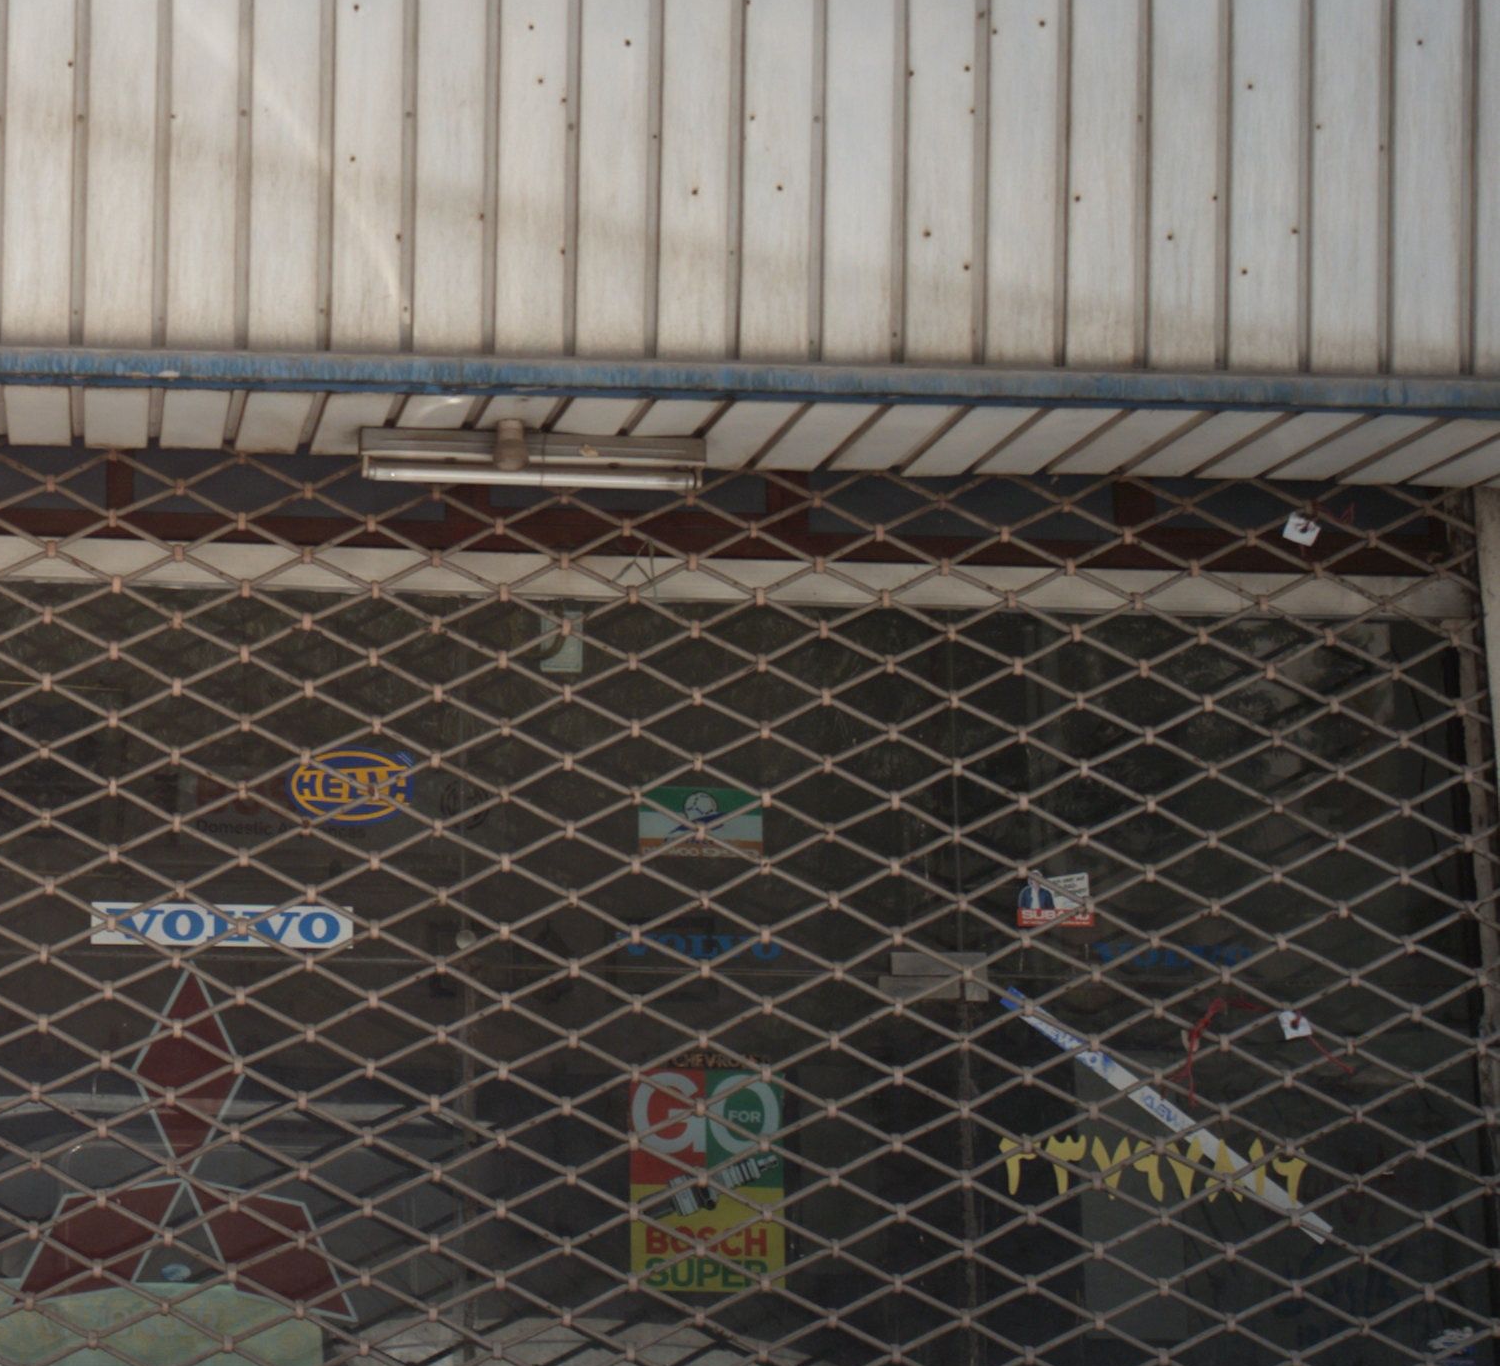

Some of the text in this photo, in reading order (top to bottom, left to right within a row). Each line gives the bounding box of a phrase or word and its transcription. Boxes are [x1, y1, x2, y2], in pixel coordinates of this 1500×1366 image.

[103, 908, 339, 944] VOLVO
[1021, 908, 1090, 922] SUBAU
[632, 1072, 779, 1154] GO
[728, 1109, 761, 1124] FOR
[646, 1226, 767, 1257] BOSCH
[644, 1257, 768, 1288] SUPER
